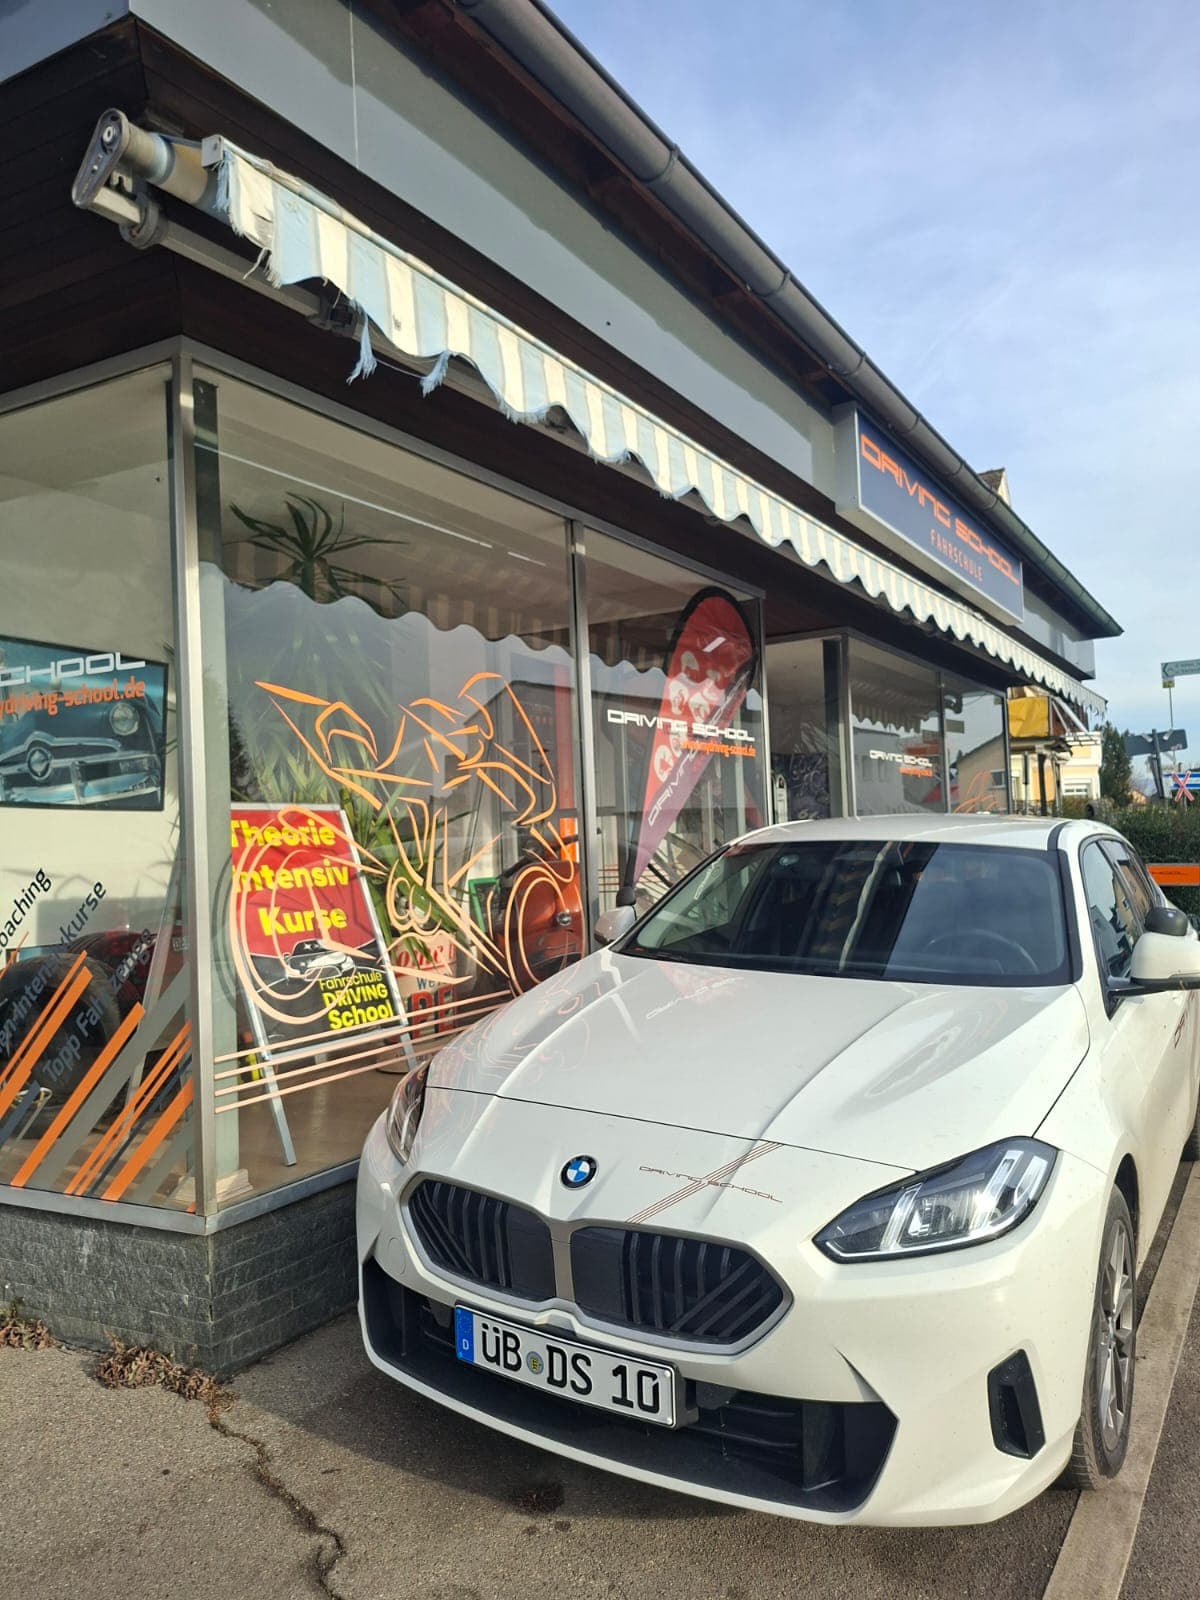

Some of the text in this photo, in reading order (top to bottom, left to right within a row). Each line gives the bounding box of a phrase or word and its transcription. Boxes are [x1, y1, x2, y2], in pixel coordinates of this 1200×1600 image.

[861, 433, 1020, 585] DRIVING SCHOOL
[930, 528, 983, 582] FAHRSCHULE
[0, 652, 146, 687] CHOOL
[607, 709, 755, 742] DRIVING SCHOOL
[231, 818, 336, 848] Theorie
[0, 868, 52, 956] oaching
[258, 905, 348, 937] Kurse
[320, 970, 383, 990] Fahrschule
[322, 983, 389, 1008] DRIVING
[42, 928, 151, 1082] Topp Fahzeuge
[328, 1000, 394, 1030] School
[462, 1338, 470, 1351] D
[481, 1323, 661, 1414] ÜB DS 10
